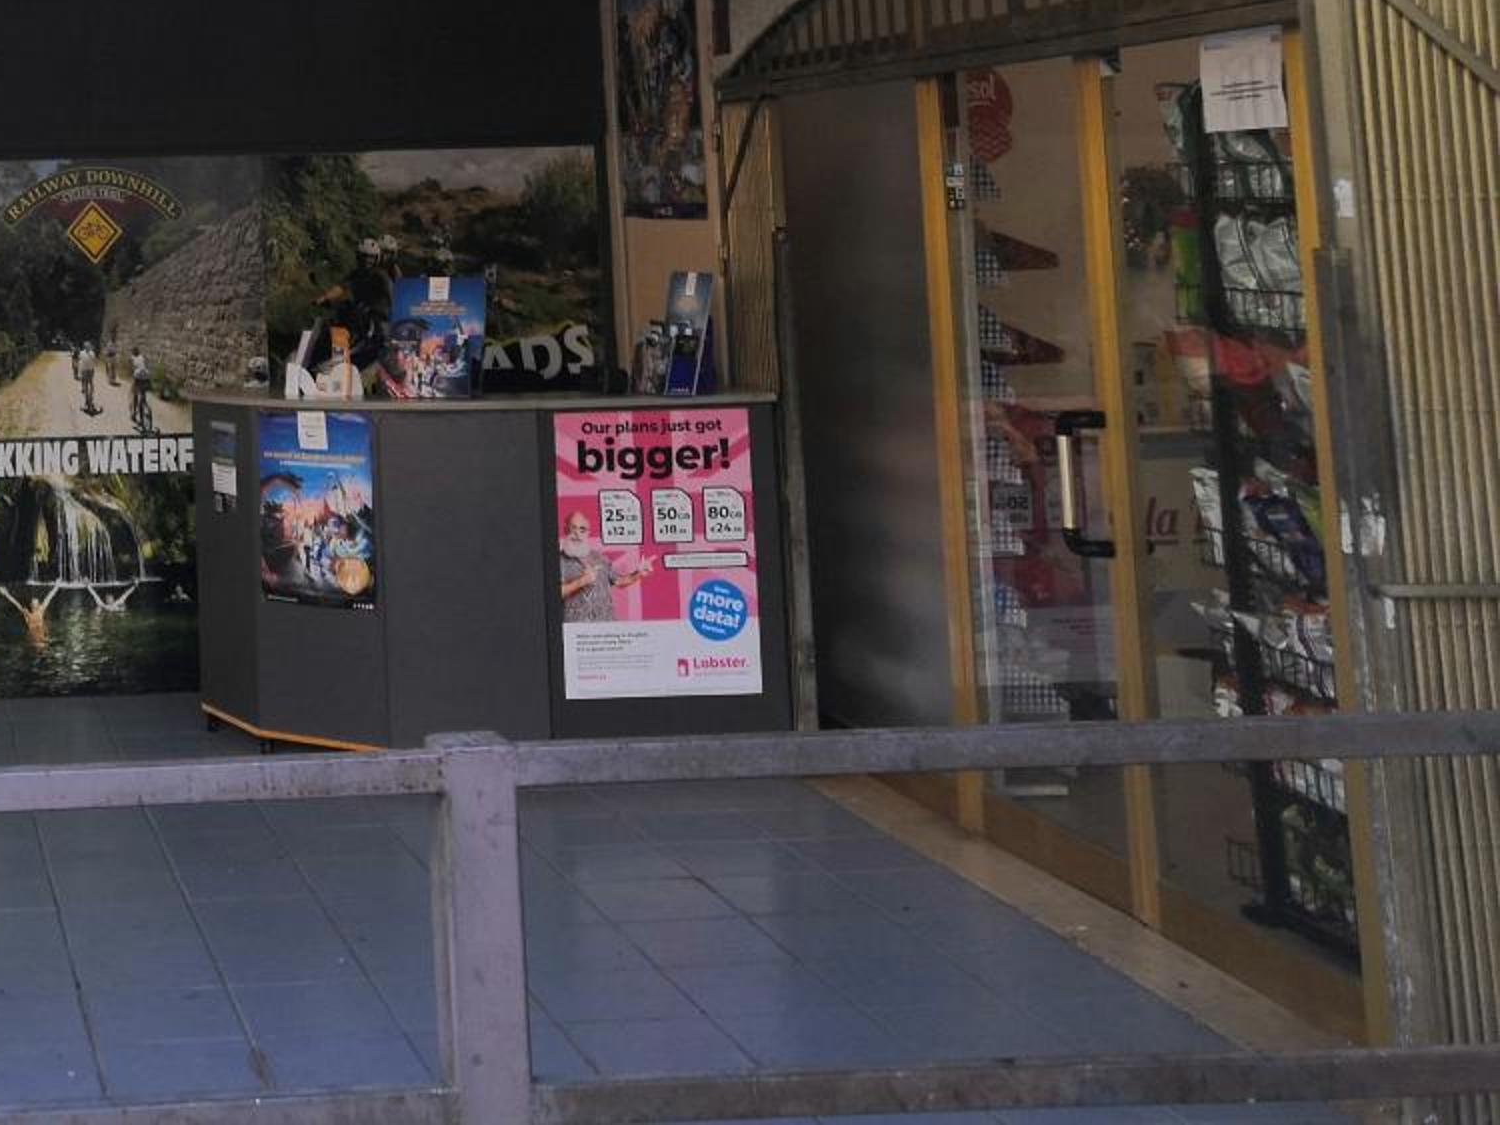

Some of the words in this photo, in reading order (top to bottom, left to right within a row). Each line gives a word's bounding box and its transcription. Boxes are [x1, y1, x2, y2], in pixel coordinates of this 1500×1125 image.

[6, 170, 81, 220] RAILWAY
[87, 169, 178, 217] DOWNHILL
[581, 422, 611, 435] Our
[615, 420, 658, 436] plans
[659, 419, 691, 435] just
[695, 418, 722, 434] got
[577, 436, 731, 479] bigger!
[696, 590, 744, 611] more
[693, 606, 741, 629] data!
